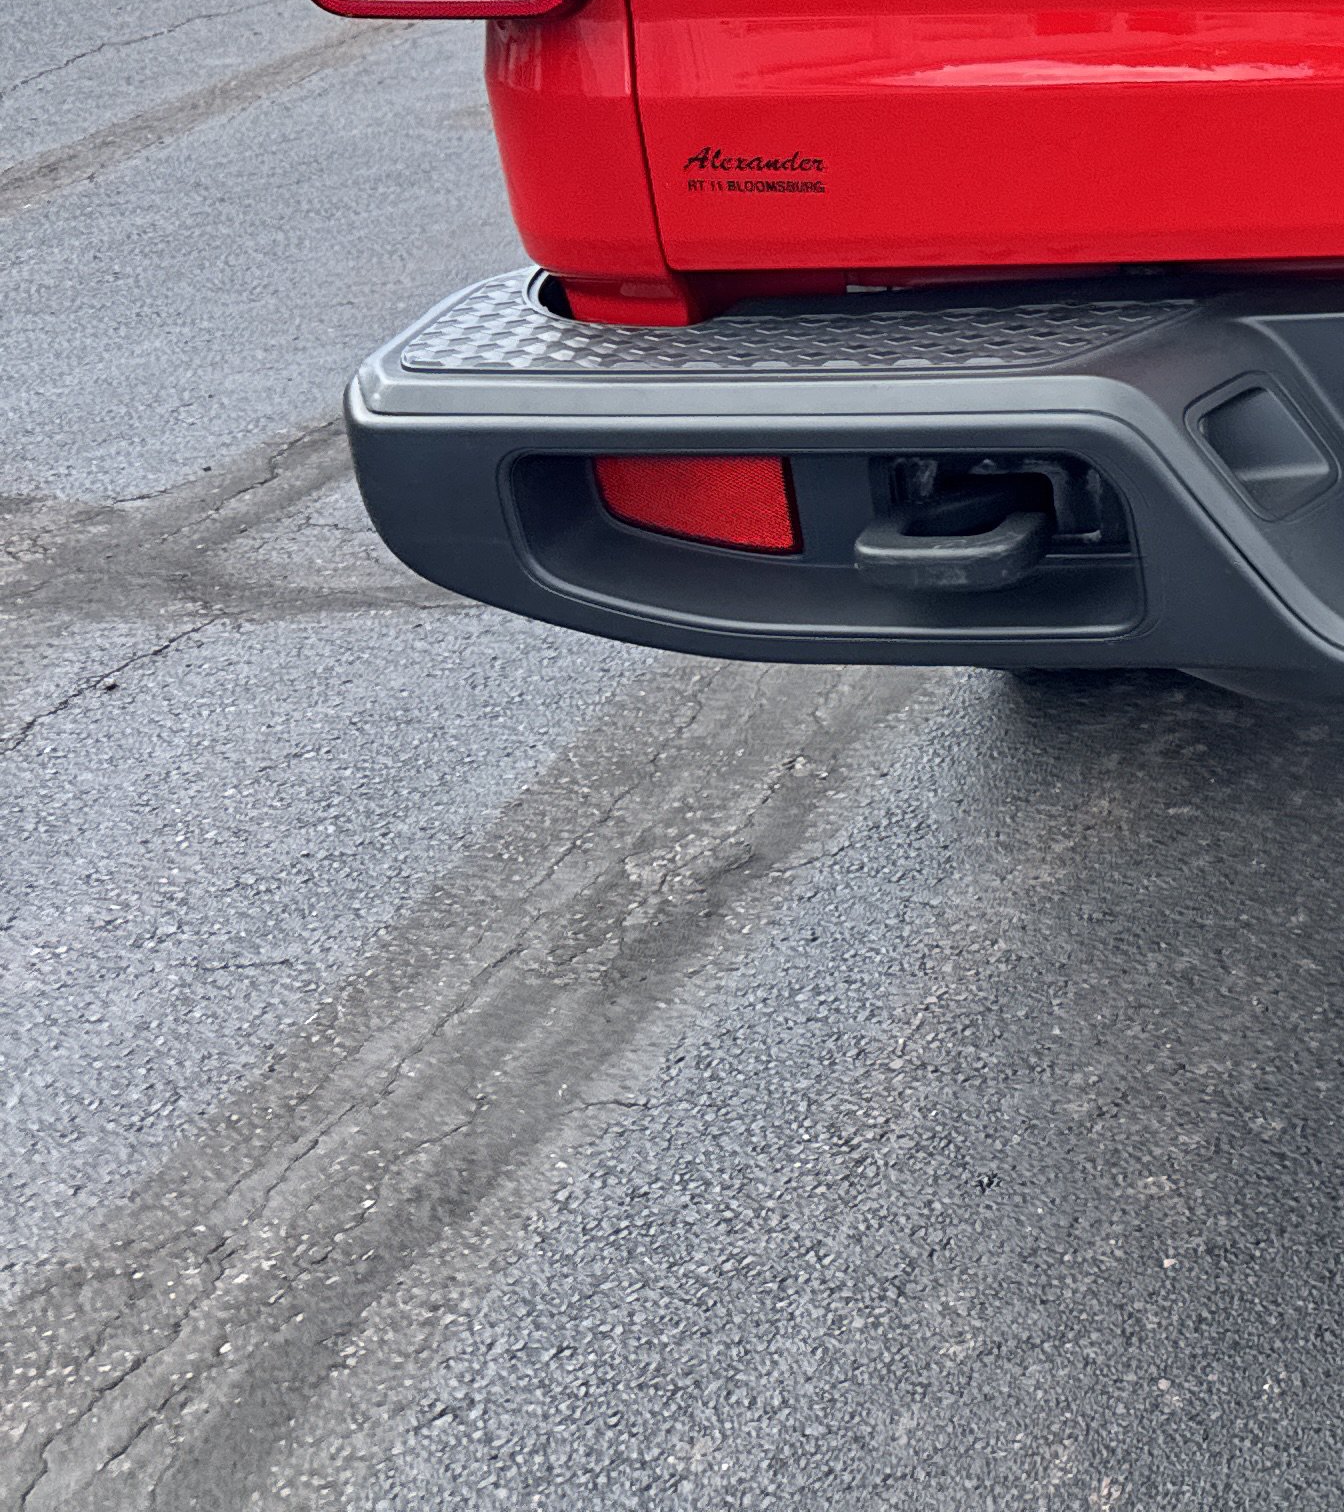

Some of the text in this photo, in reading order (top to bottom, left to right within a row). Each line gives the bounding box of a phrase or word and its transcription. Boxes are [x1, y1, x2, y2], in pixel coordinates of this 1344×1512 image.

[683, 146, 827, 172] Alexander
[687, 179, 705, 192] RT
[727, 179, 826, 193] BLOOMSBURG
